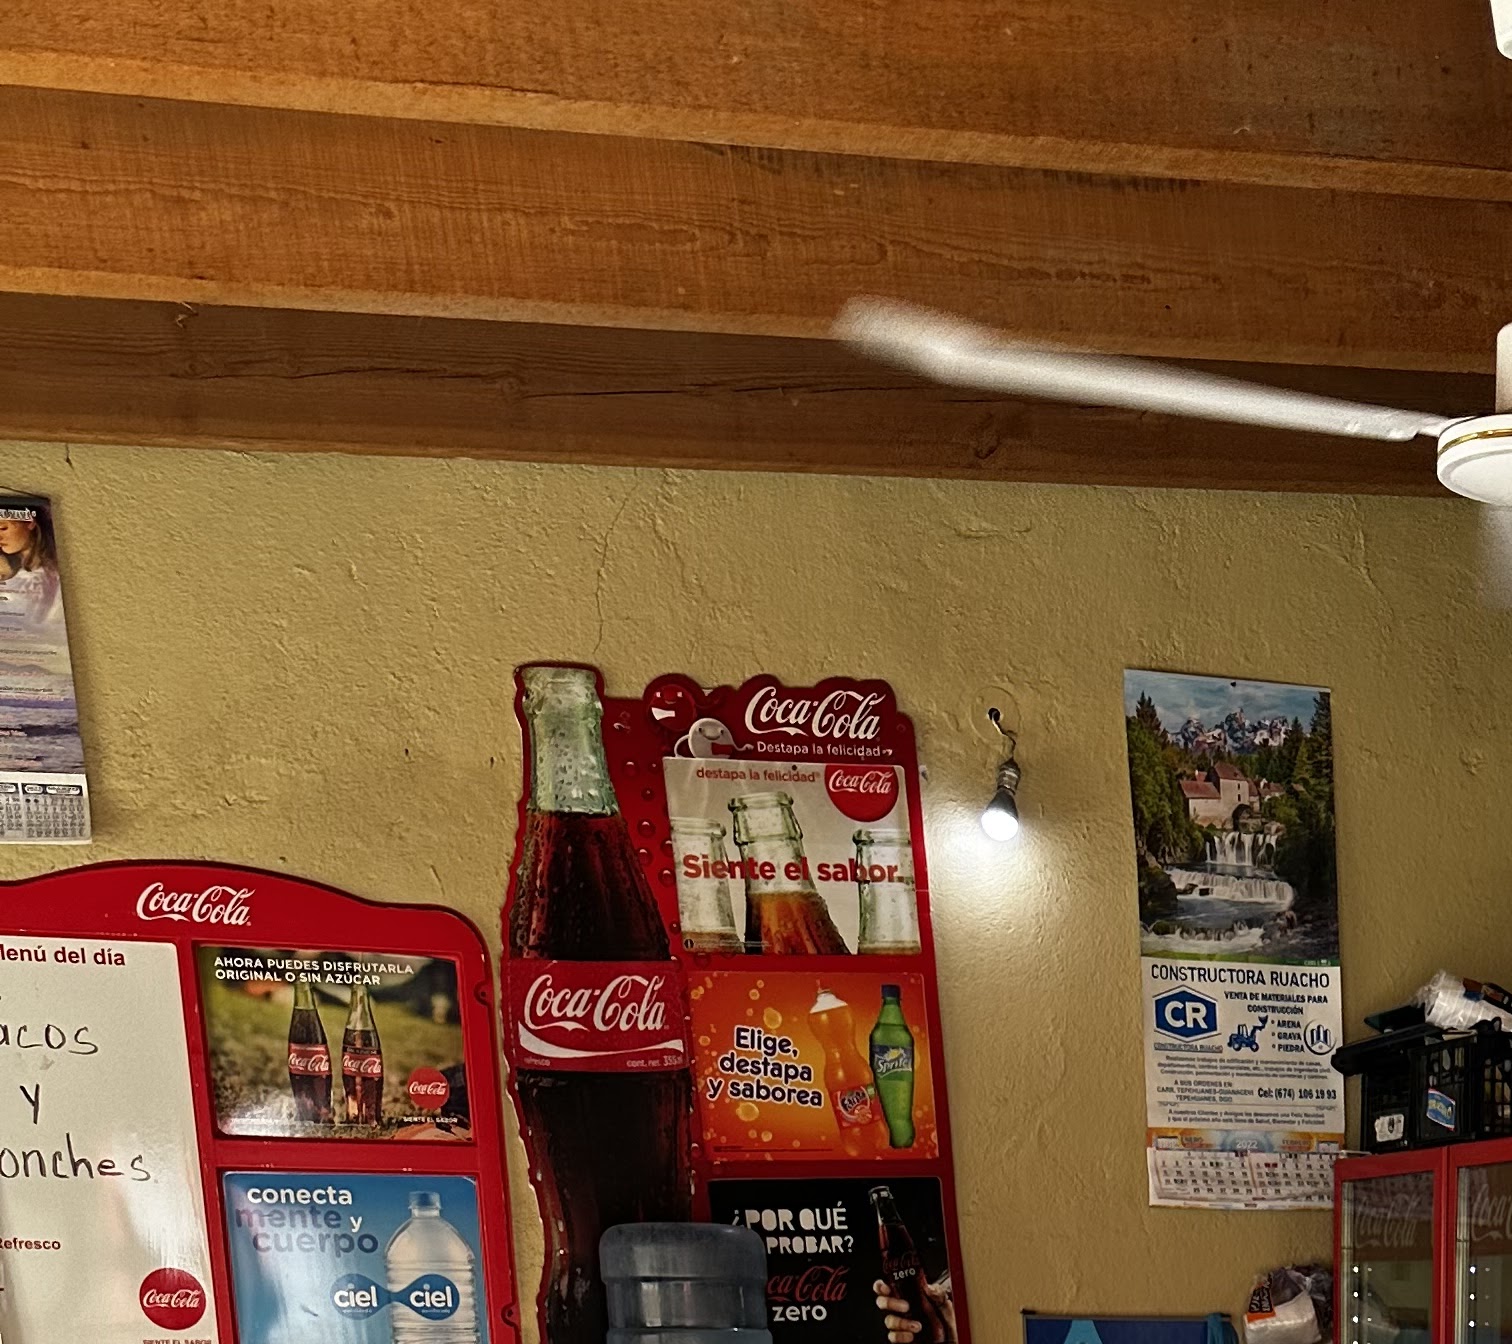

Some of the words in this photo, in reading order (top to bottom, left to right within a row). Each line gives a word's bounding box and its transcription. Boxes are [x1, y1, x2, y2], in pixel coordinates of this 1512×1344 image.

[744, 686, 887, 740] Coca-Cola
[757, 741, 809, 756] Destapa
[811, 743, 824, 756] la
[827, 743, 881, 759] felicidad
[696, 767, 747, 782] destapa
[750, 768, 761, 781] la
[763, 769, 816, 783] felicidad
[829, 769, 894, 794] Coca-Cola
[682, 854, 776, 881] Siente
[784, 856, 808, 881] el
[136, 882, 255, 926] Coca-Cola
[54, 947, 86, 964] del
[94, 947, 125, 966] día
[214, 956, 263, 970] AHORA
[267, 958, 320, 972] PUEDES
[323, 960, 414, 975] DISFRUTARLA
[215, 969, 282, 982] ORIGINAL
[285, 971, 296, 983] O
[299, 972, 323, 984] SIN
[325, 972, 381, 986] AZÚCAR
[1151, 964, 1266, 986] CONSTRUCTORA
[1270, 971, 1330, 988] RUACHO
[524, 974, 667, 1033] Coca-Cola
[1164, 1001, 1208, 1029] CR
[1277, 1020, 1301, 1029] ARENA
[733, 1026, 799, 1057] Elige,
[1277, 1044, 1305, 1053] PIEDRA
[719, 1053, 813, 1082] destapa
[877, 1058, 912, 1073] Sprite
[707, 1077, 724, 1100] y
[729, 1079, 823, 1108] saborea
[1275, 1087, 1295, 1101] (674)
[1326, 1089, 1337, 1100] 93
[1235, 1140, 1258, 1149] 2022
[247, 1186, 353, 1205] conecta
[235, 1206, 342, 1230] mente
[349, 1215, 363, 1233] y
[799, 1201, 848, 1231] QUÉ
[252, 1231, 379, 1258] cuerpo
[766, 1235, 854, 1255] PROBAR?
[767, 1265, 850, 1302] ca-Cola
[893, 1267, 916, 1281] zero
[143, 1288, 201, 1309] Coca-Cola
[333, 1283, 378, 1308] ciel
[409, 1283, 453, 1308] ciel
[771, 1305, 828, 1322] zero
